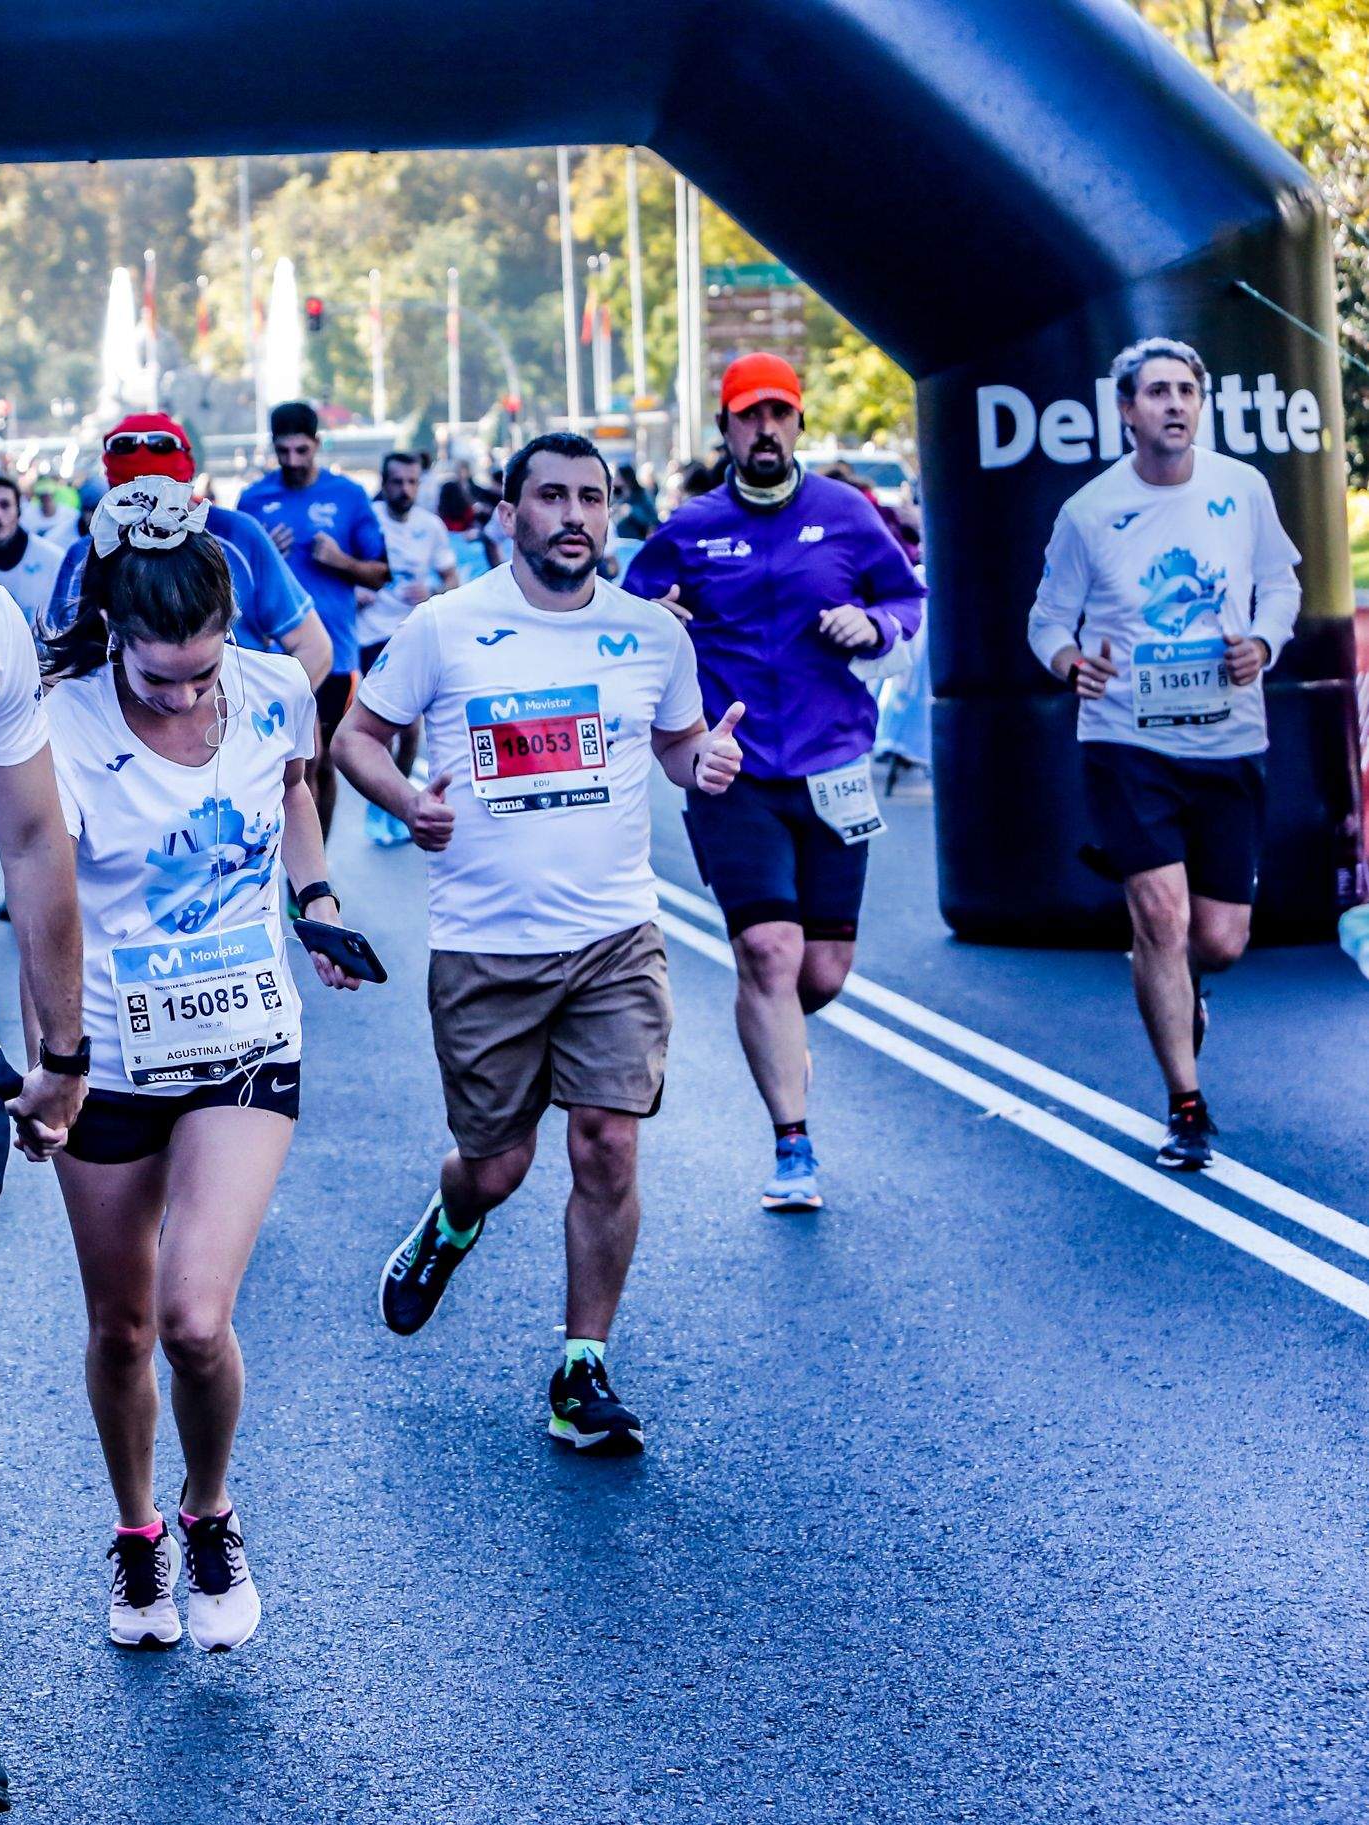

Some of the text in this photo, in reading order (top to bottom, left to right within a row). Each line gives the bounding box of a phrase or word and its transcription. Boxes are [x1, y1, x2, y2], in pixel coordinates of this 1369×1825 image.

[976, 372, 1332, 470] Delitte.
[1159, 670, 1211, 689] 13617
[524, 697, 573, 711] Movistar
[501, 731, 572, 758] 18053
[533, 779, 550, 788] EDU
[571, 791, 605, 803] MADRID
[189, 942, 245, 963] Movistar
[161, 984, 249, 1022] 15085
[166, 1045, 222, 1061] AGUSTINA
